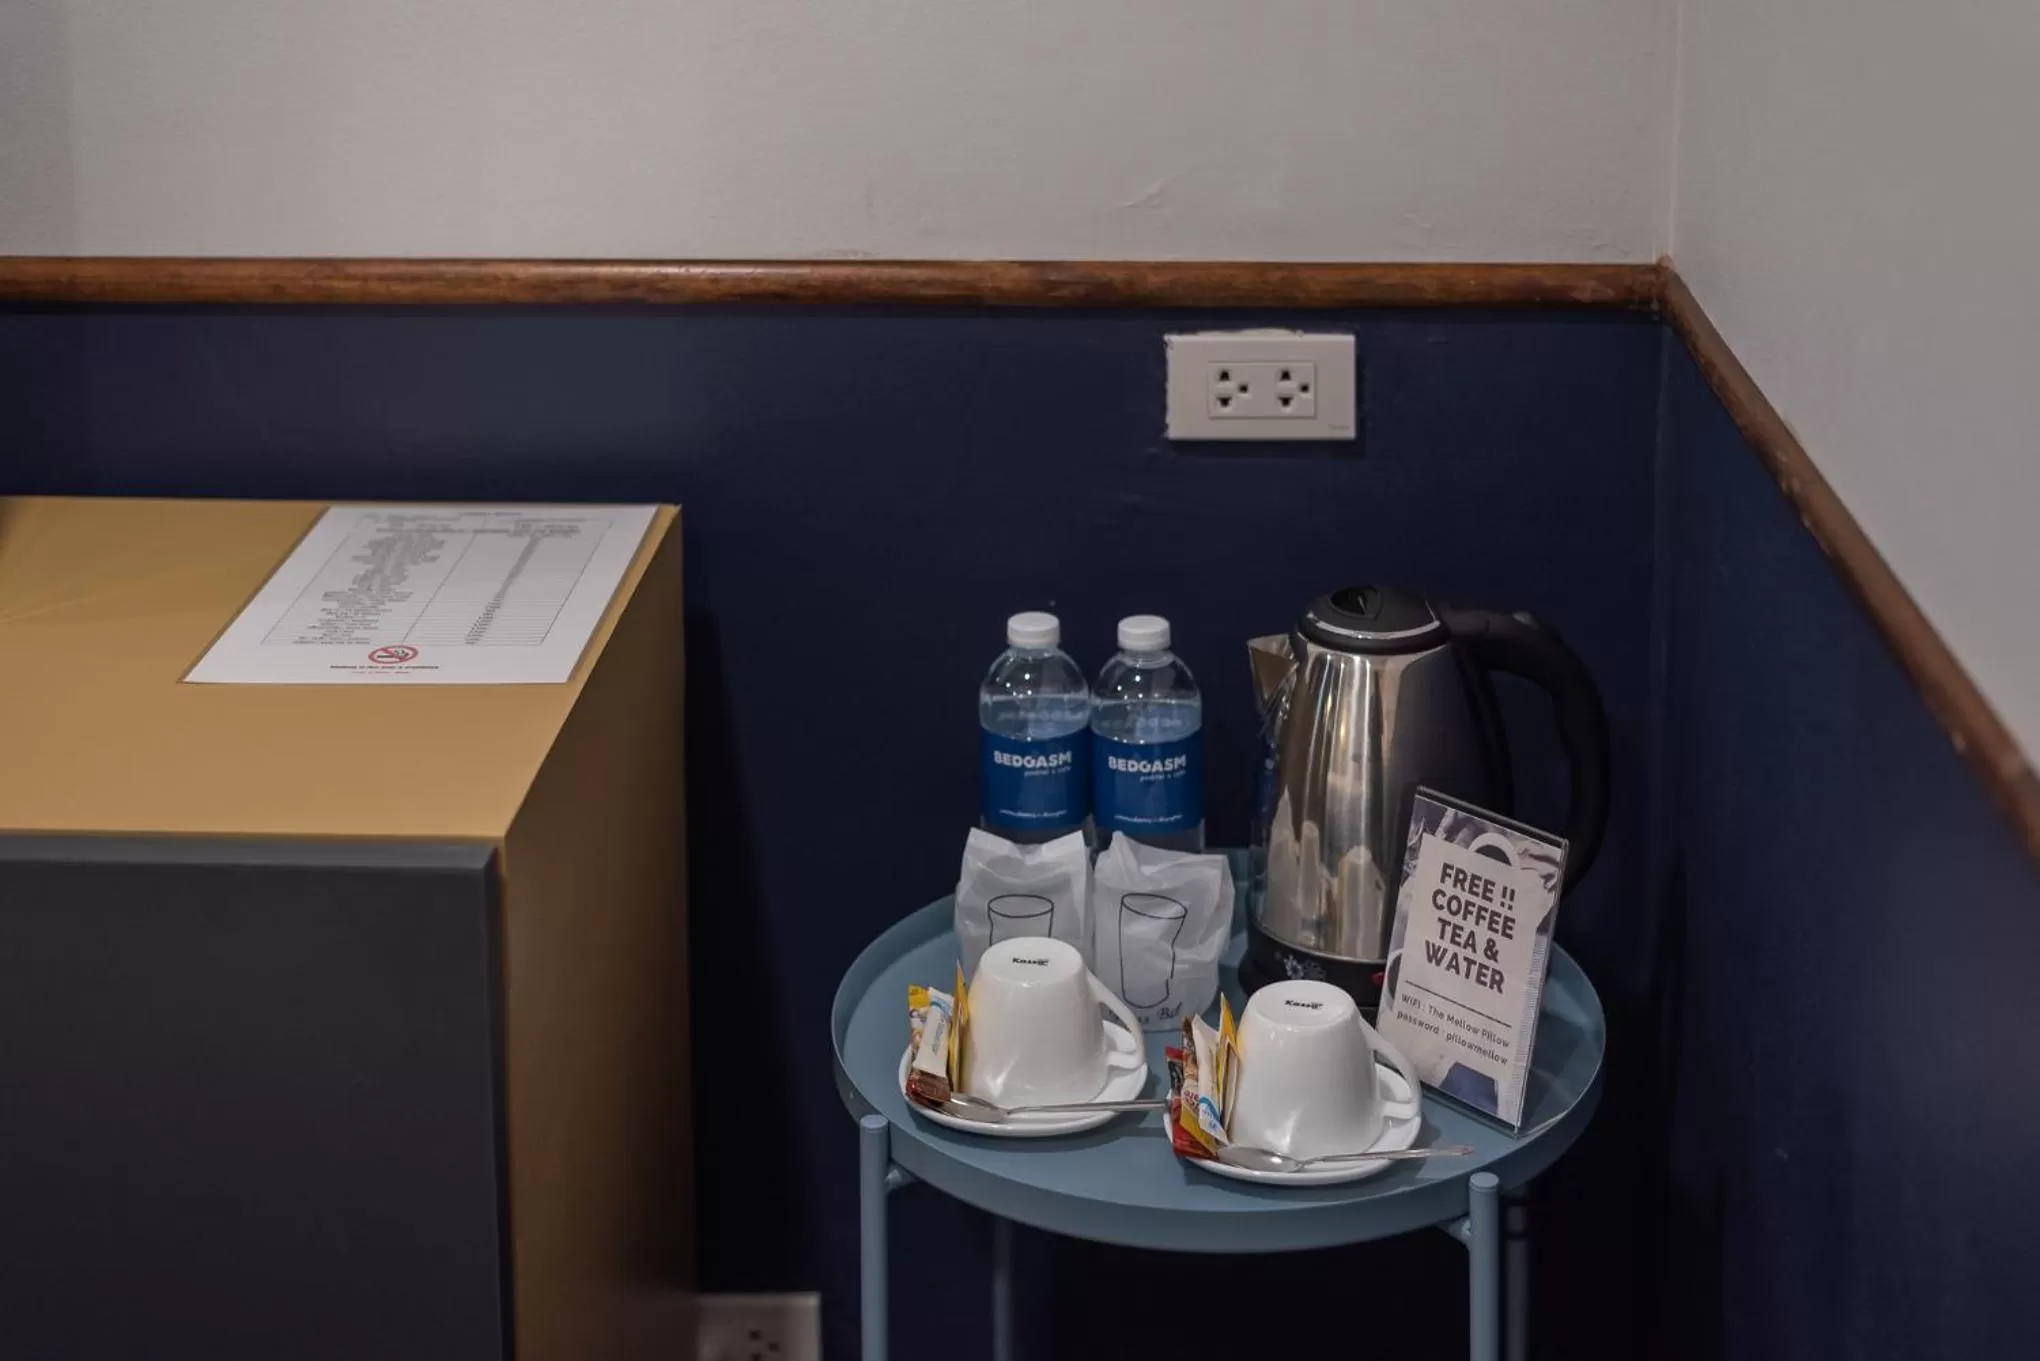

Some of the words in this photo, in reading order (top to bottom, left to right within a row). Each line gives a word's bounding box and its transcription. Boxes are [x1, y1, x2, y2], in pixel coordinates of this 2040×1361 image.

[993, 750, 1072, 768] BEDGASM
[1108, 754, 1187, 773] BEDGASM
[1440, 862, 1496, 903] FREE
[1500, 886, 1516, 911] !!
[1432, 888, 1516, 940] COFFEE
[1438, 917, 1477, 954] TEA
[1483, 937, 1499, 964] &
[1425, 940, 1505, 994] WATER
[1397, 1010, 1440, 1034] password
[1446, 1032, 1508, 1065] pillowmellow
[1429, 1005, 1444, 1020] The
[1447, 1014, 1480, 1034] Mellow
[1482, 1028, 1509, 1048] Pillow
